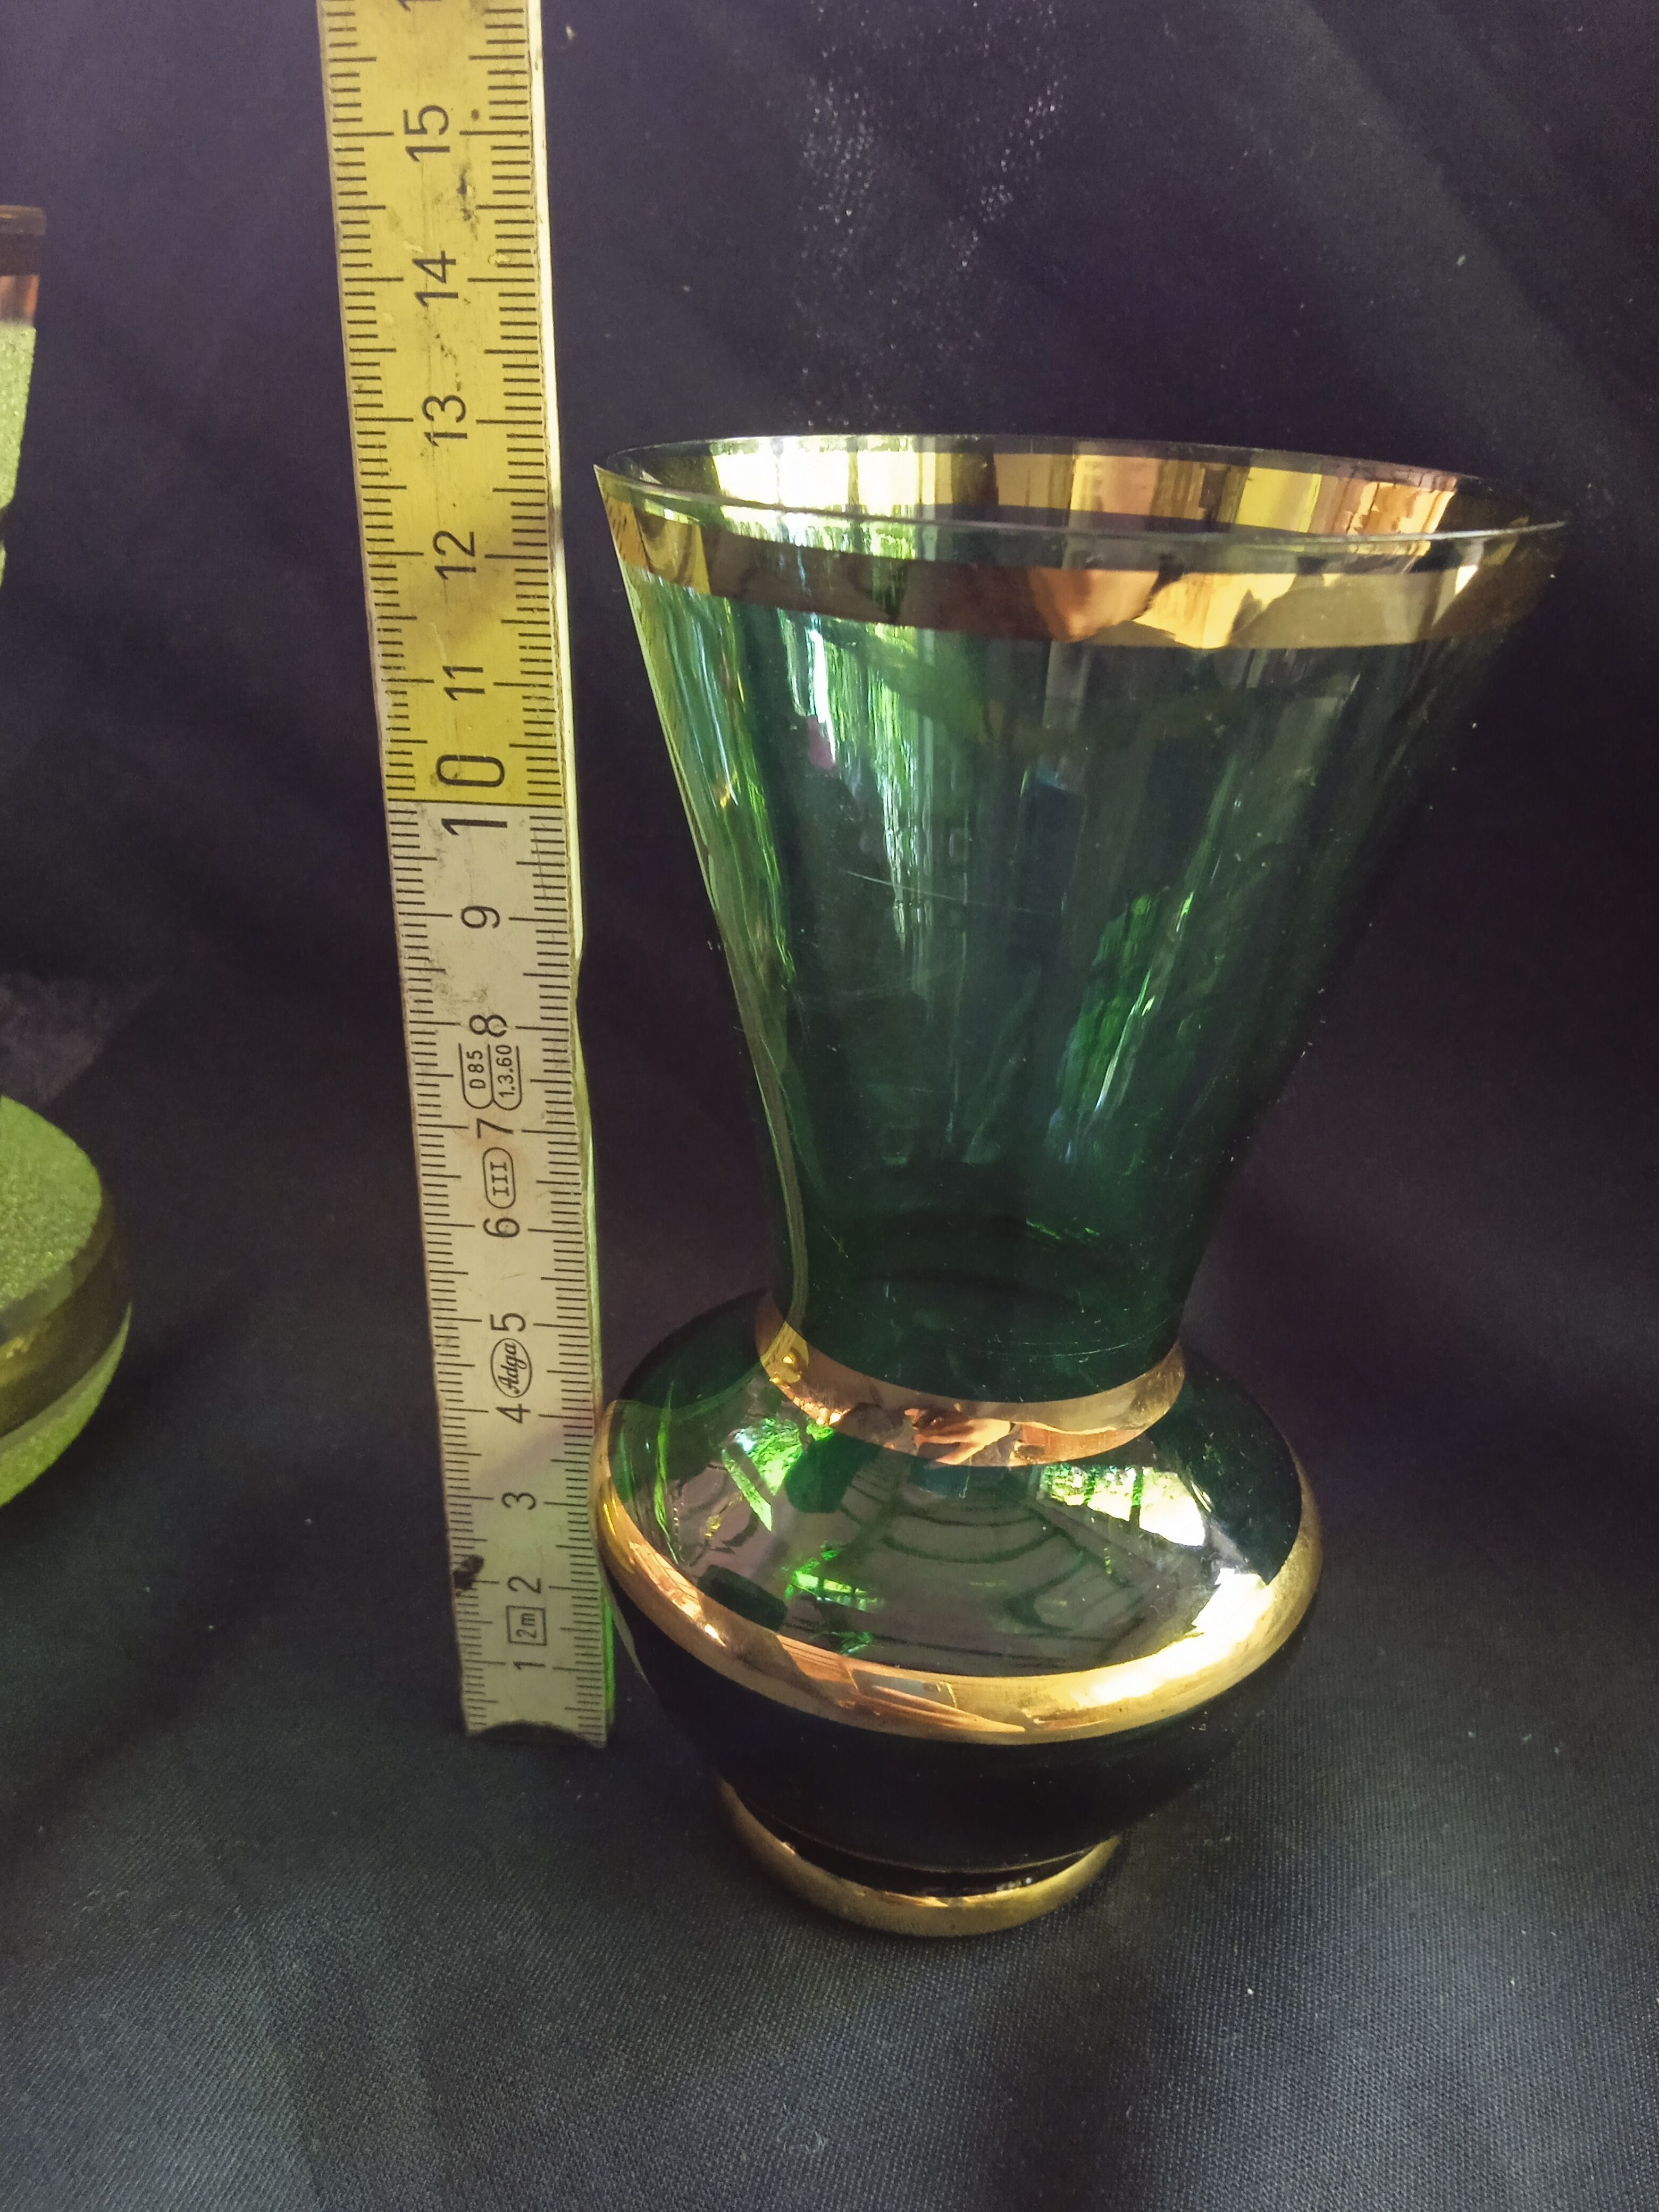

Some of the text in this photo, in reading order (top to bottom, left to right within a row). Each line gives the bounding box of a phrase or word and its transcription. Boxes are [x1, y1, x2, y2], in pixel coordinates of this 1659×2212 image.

[404, 105, 450, 162] 15
[412, 250, 458, 307] 14
[422, 395, 467, 447] 13
[432, 531, 476, 580] 12
[442, 666, 485, 701] 11
[460, 906, 500, 929] 9
[468, 1015, 508, 1037] 8
[496, 1044, 516, 1098] 1.3.60
[476, 1118, 514, 1139] 7
[490, 1161, 509, 1196] III
[483, 1218, 520, 1237] 6
[489, 1313, 526, 1332] 5
[498, 1342, 527, 1394] Adga
[495, 1404, 531, 1424] 4
[501, 1492, 537, 1510] 3
[507, 1576, 541, 1594] 2
[513, 1661, 546, 1670] 1
